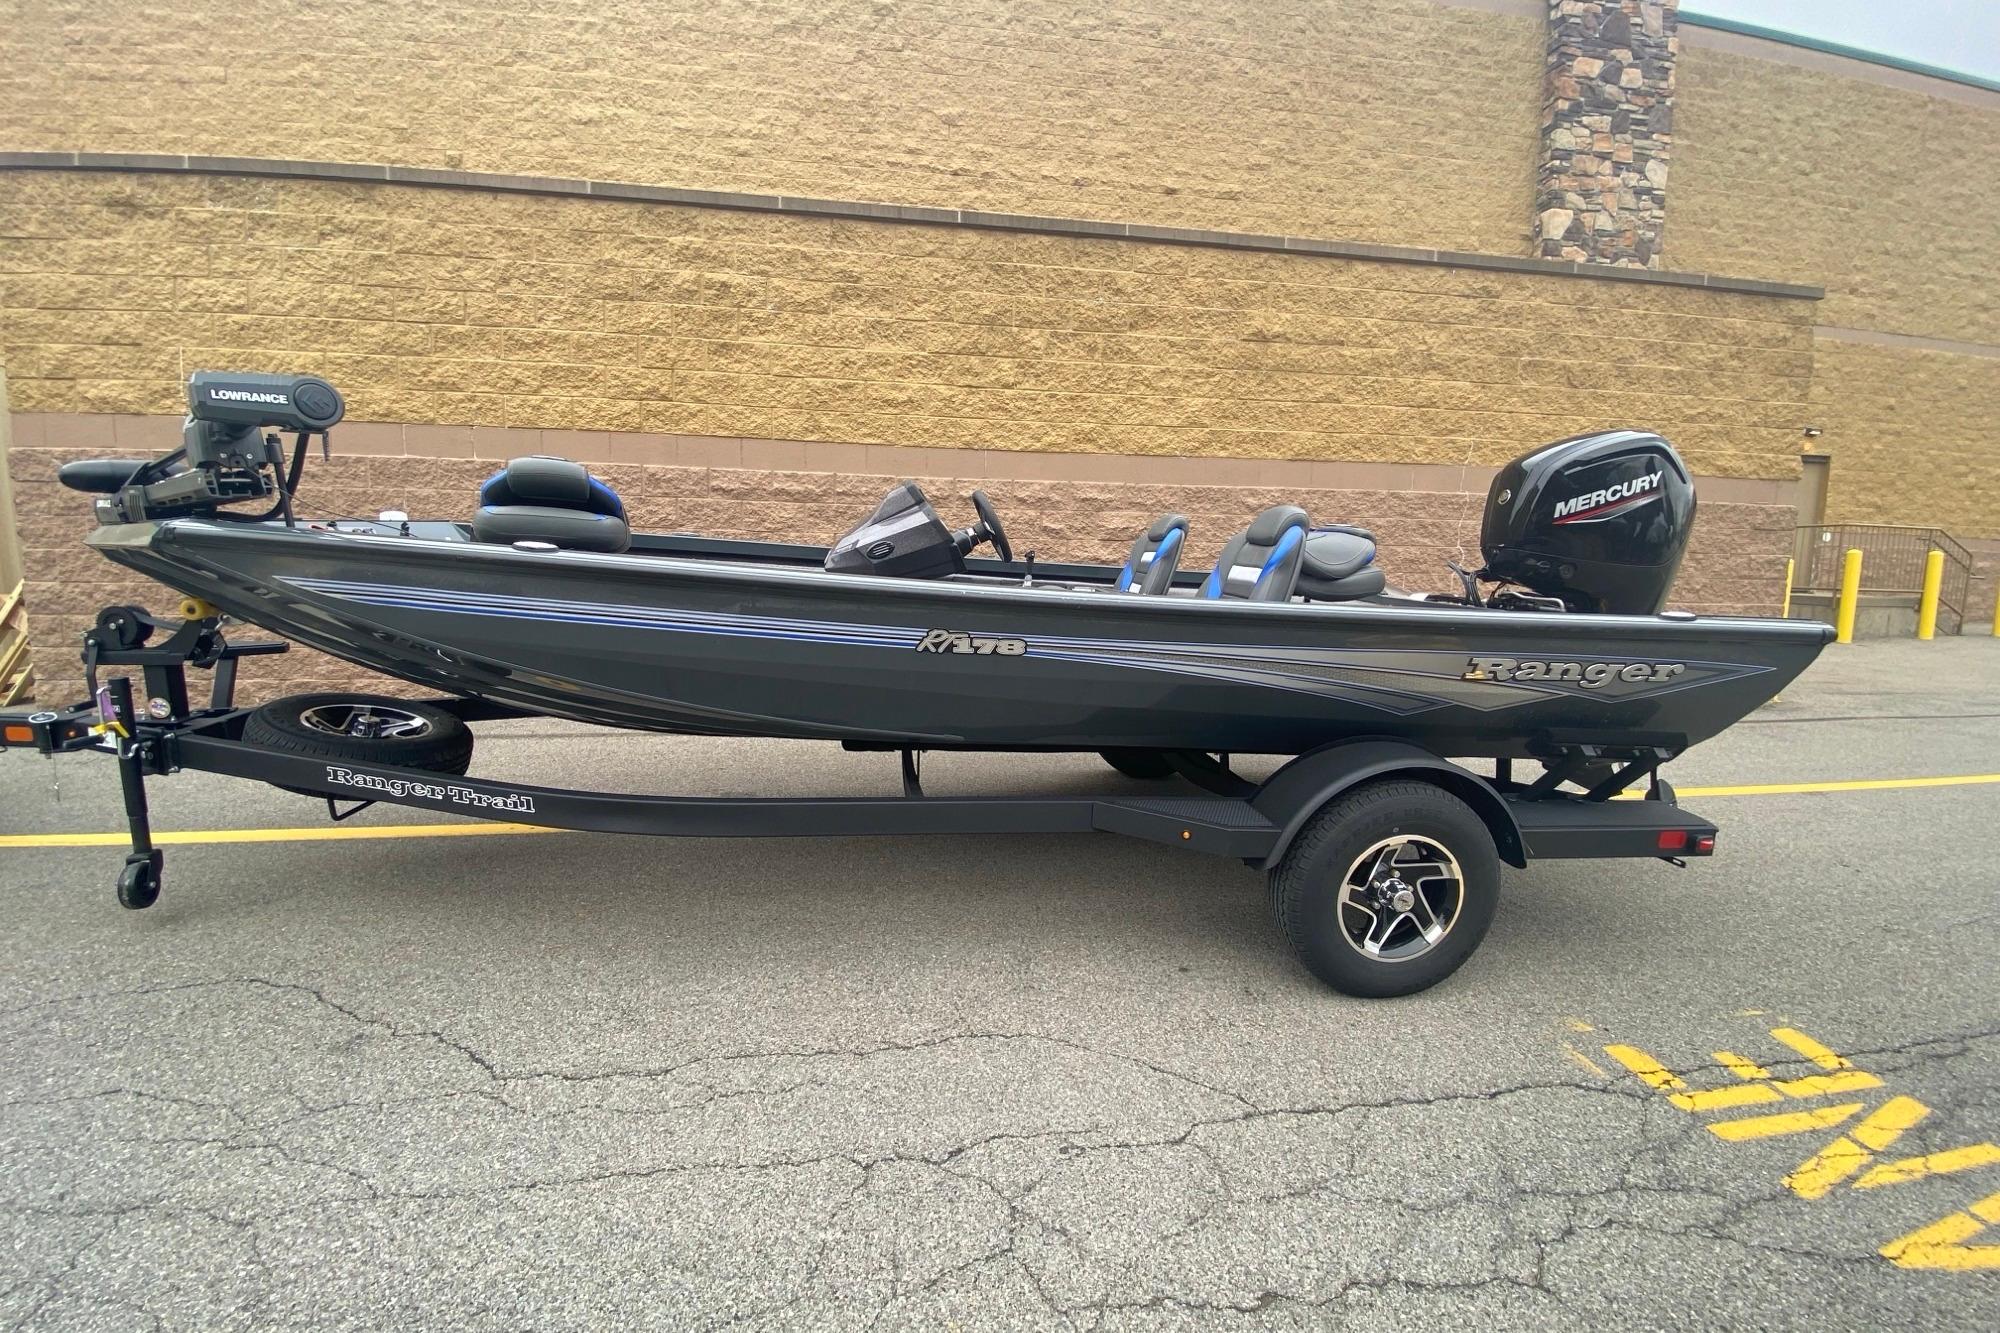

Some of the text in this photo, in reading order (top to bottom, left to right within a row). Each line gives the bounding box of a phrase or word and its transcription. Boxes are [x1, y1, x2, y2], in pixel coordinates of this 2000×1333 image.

[210, 389, 289, 405] LOWRANCE
[1553, 470, 1663, 519] MERCURY
[1464, 657, 1687, 689] Ranger
[326, 766, 536, 813] Ranger Trail
